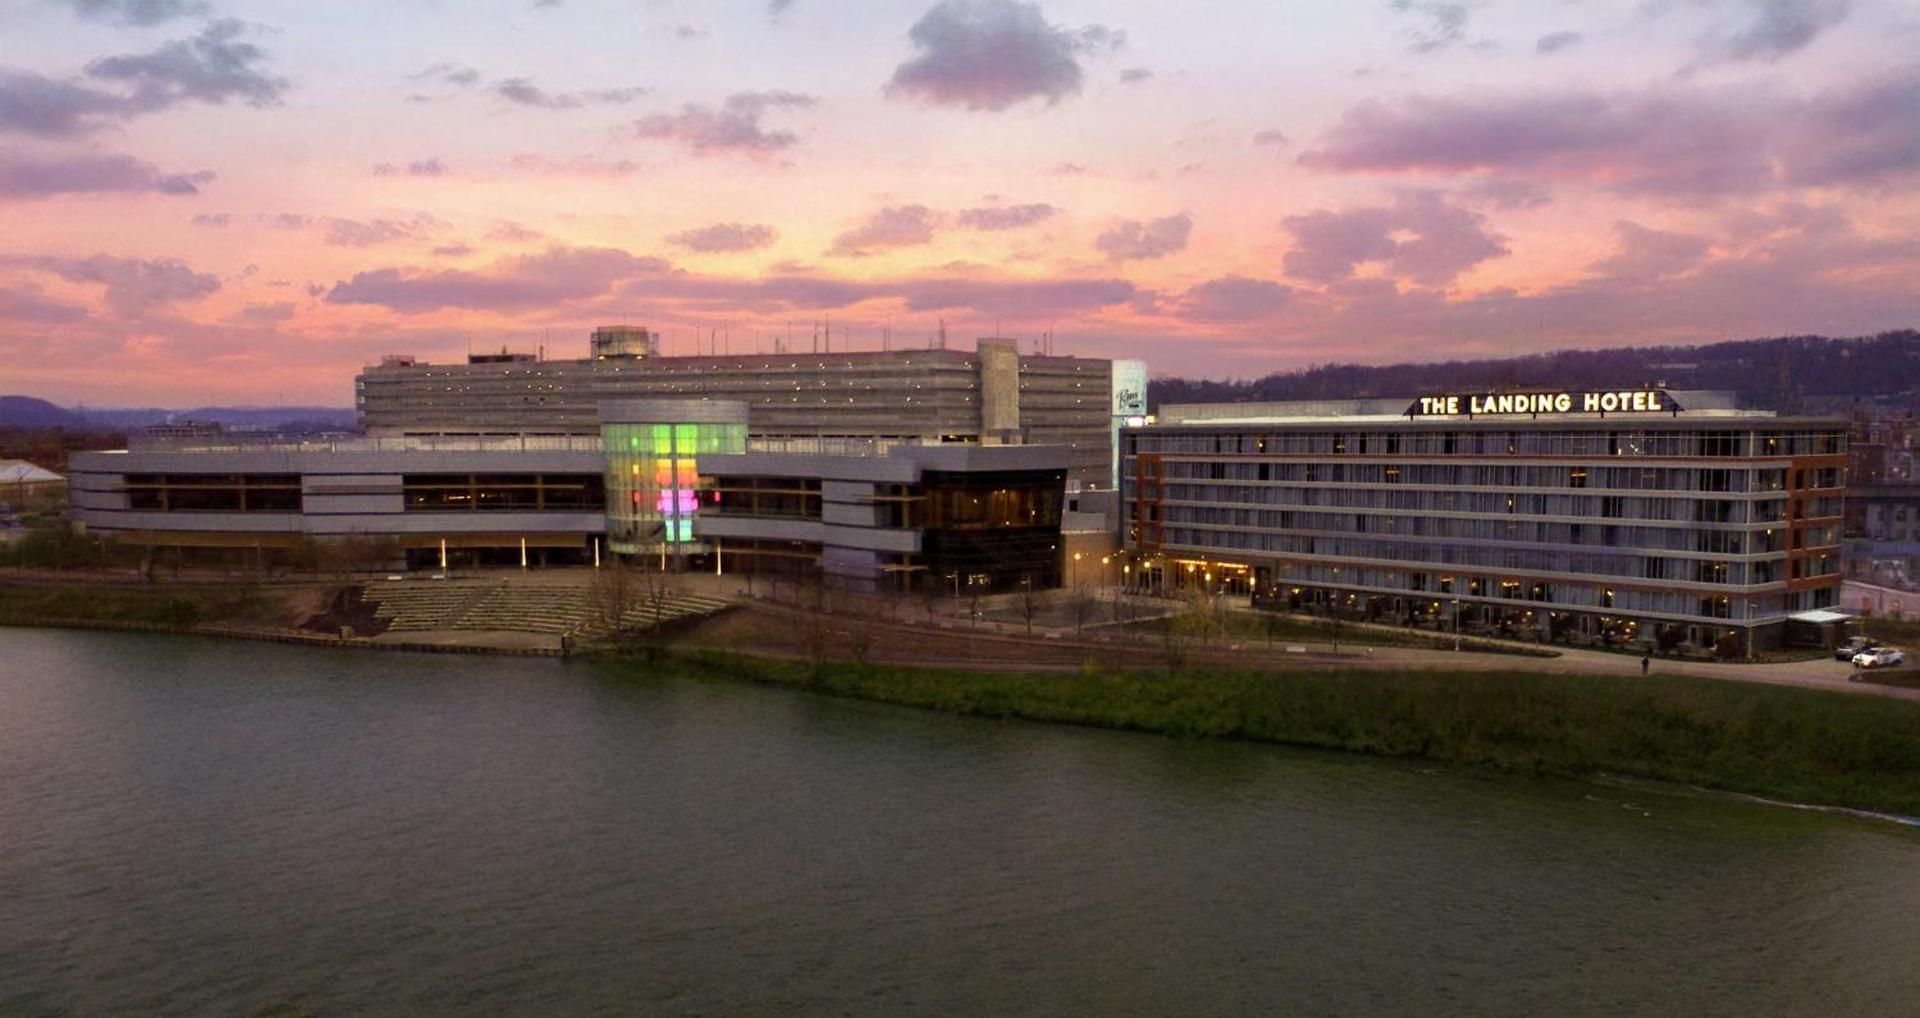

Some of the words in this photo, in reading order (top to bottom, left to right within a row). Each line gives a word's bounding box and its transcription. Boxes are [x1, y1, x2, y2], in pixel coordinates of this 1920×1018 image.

[1421, 397, 1458, 414] THE
[1471, 394, 1571, 413] LANDING
[1584, 392, 1661, 411] HOTEL
